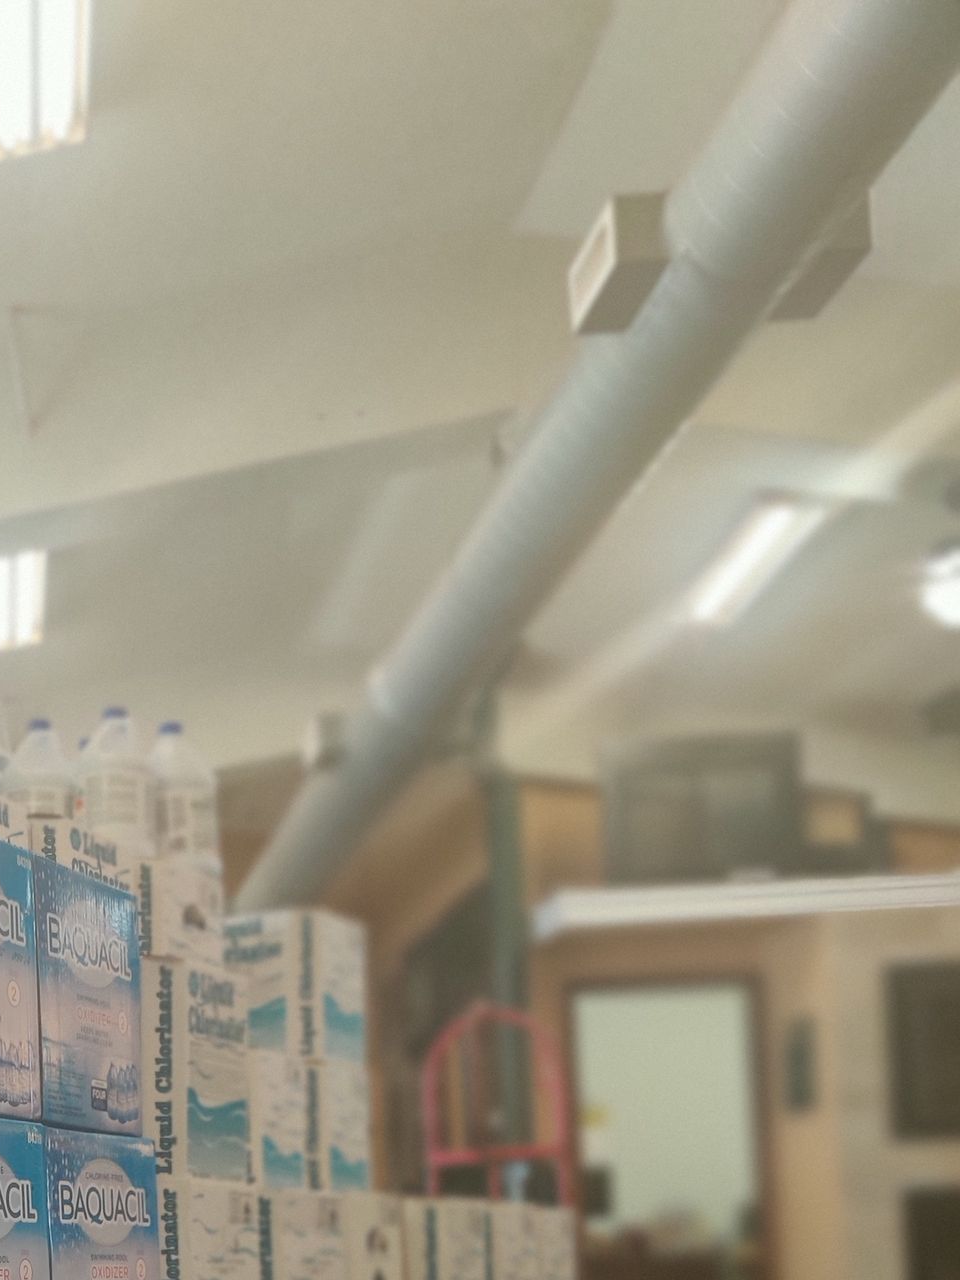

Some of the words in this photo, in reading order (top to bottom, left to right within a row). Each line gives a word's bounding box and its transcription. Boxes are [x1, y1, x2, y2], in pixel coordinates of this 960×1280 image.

[49, 916, 131, 979] BAQUACIL
[154, 966, 173, 1094] Chlorinator
[92, 1088, 107, 1099] FOUR
[155, 1101, 176, 1175] Liquid
[60, 1180, 150, 1224] BAQUACIL
[91, 1266, 129, 1279] OXIDIZER
